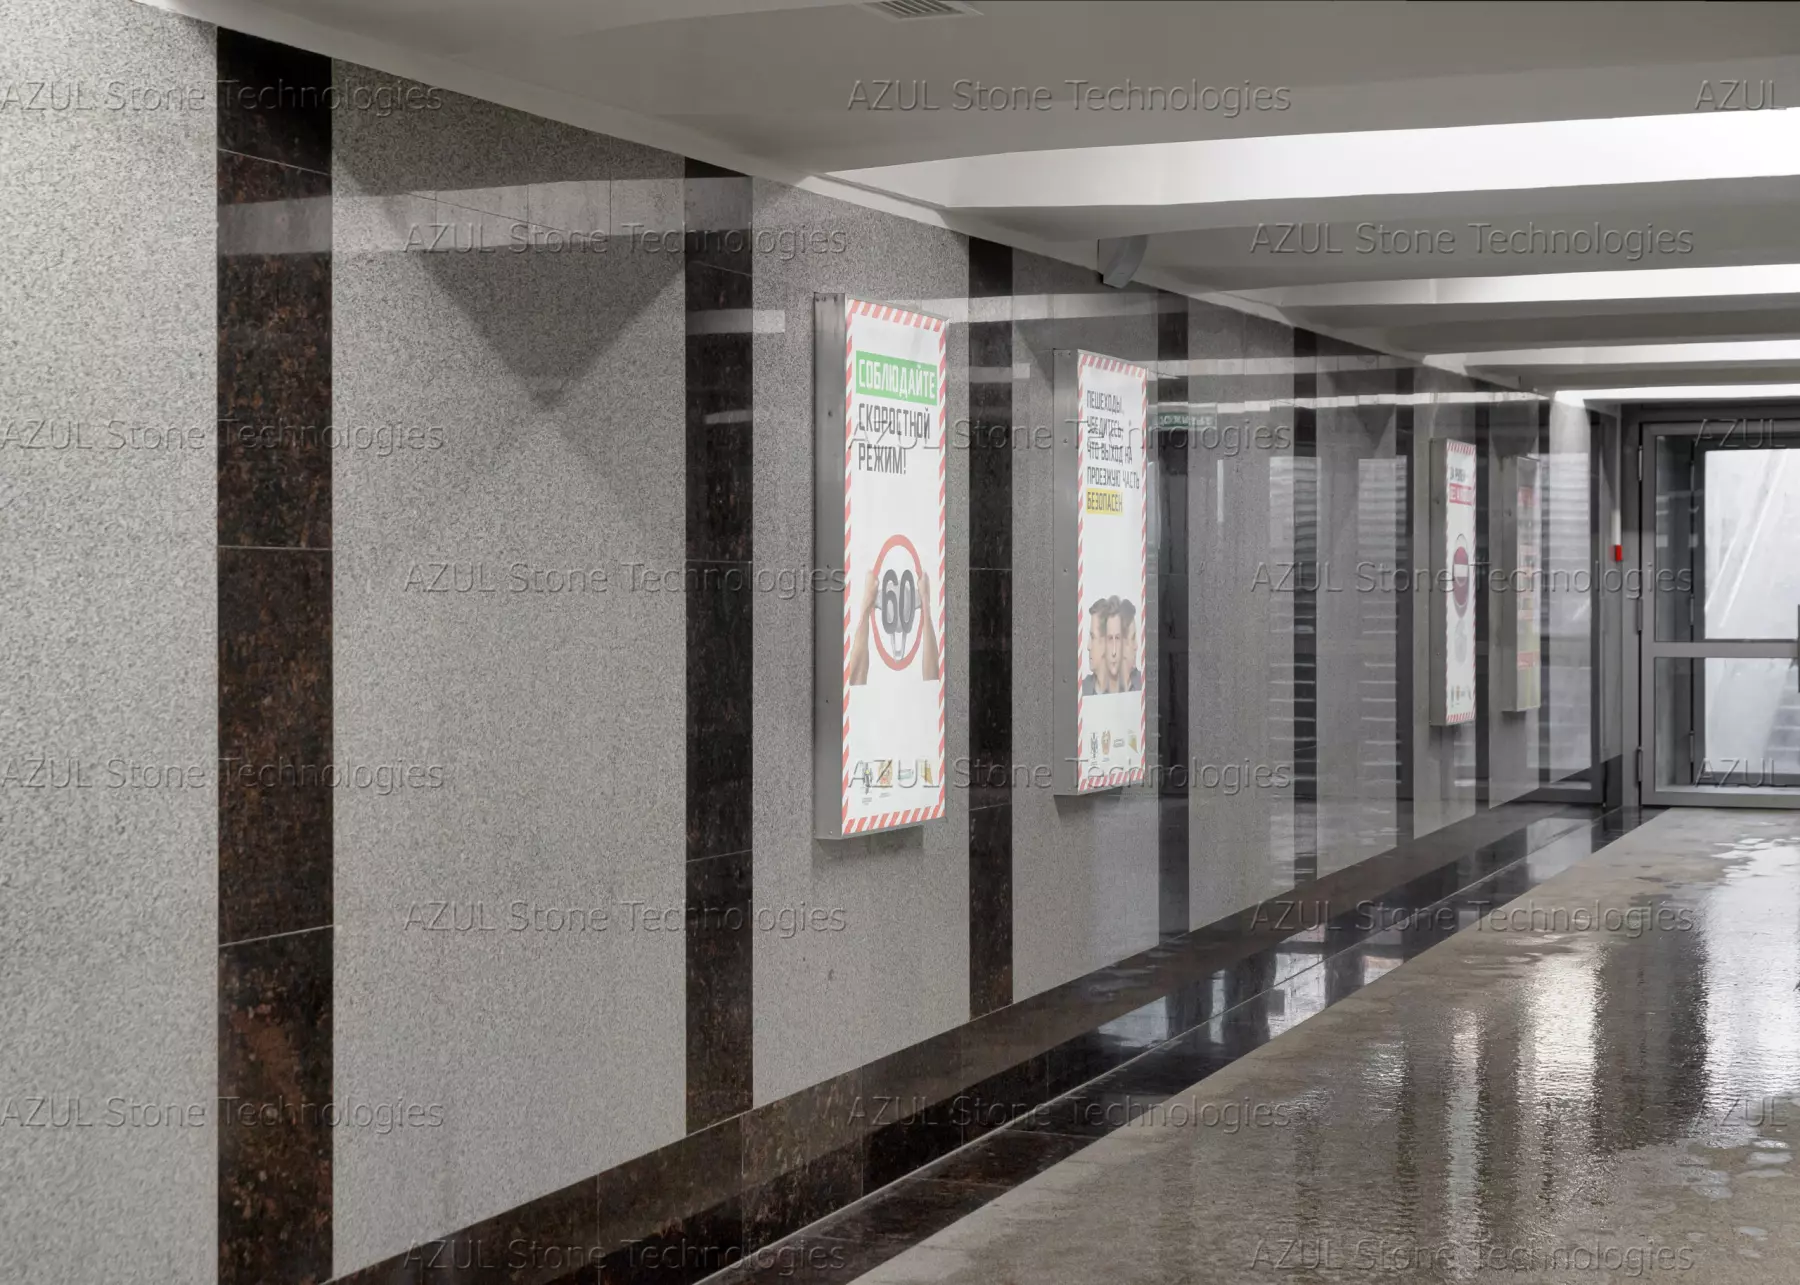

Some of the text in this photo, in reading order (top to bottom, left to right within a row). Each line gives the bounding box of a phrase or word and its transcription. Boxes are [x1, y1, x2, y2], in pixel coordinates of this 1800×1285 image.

[858, 359, 936, 400] СОБЛЮДАЙТЕ
[858, 403, 931, 440] СКОРОСТНОЙ
[858, 442, 907, 475] РЕЖИМ!
[881, 569, 915, 634] 60
